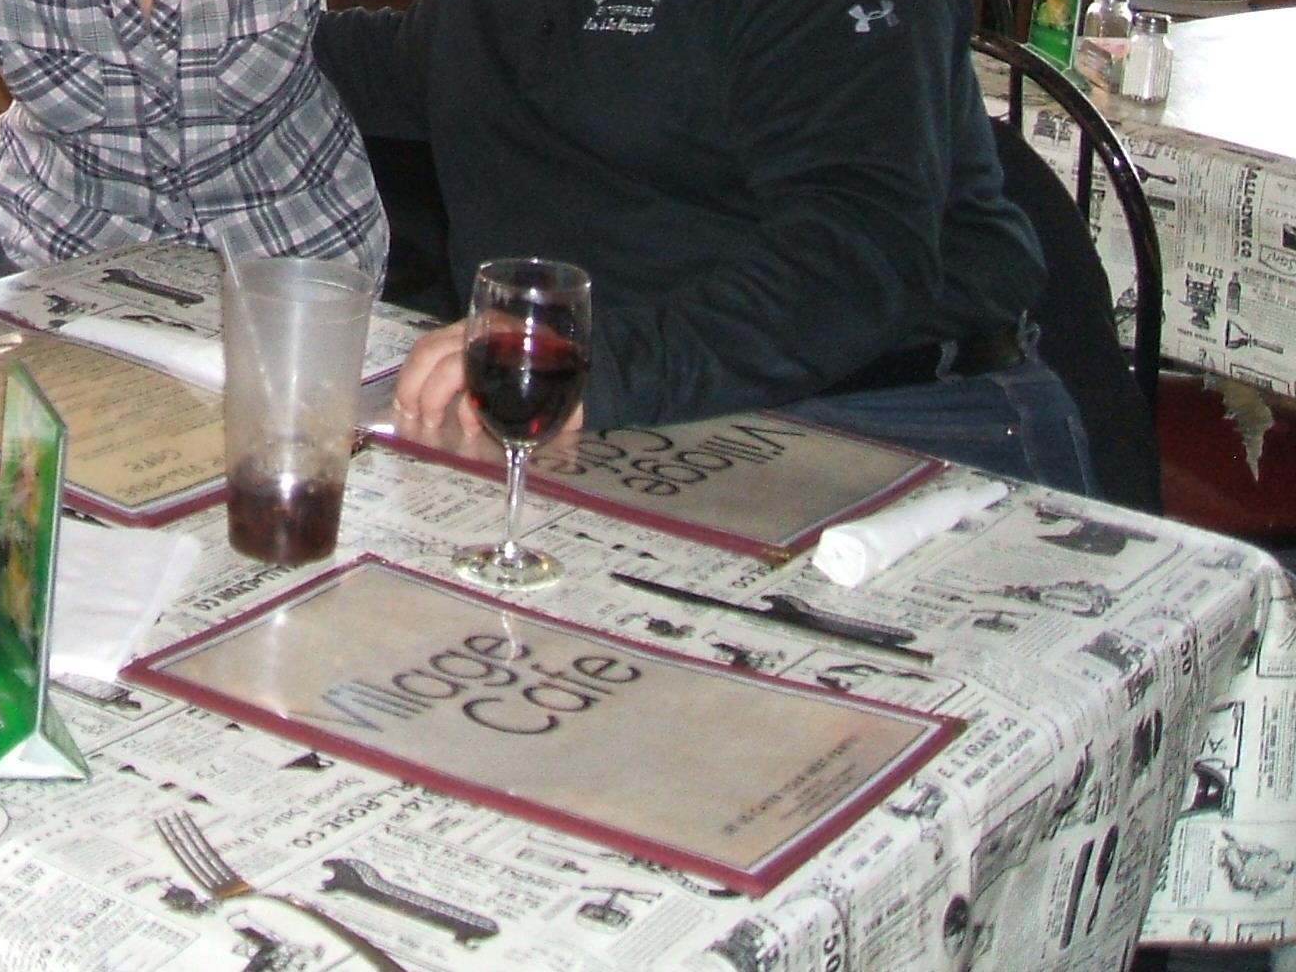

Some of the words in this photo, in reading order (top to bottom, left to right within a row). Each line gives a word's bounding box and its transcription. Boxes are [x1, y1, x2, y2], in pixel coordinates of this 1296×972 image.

[621, 424, 807, 497] Village
[288, 632, 531, 734] Village
[461, 654, 643, 736] Cafe
